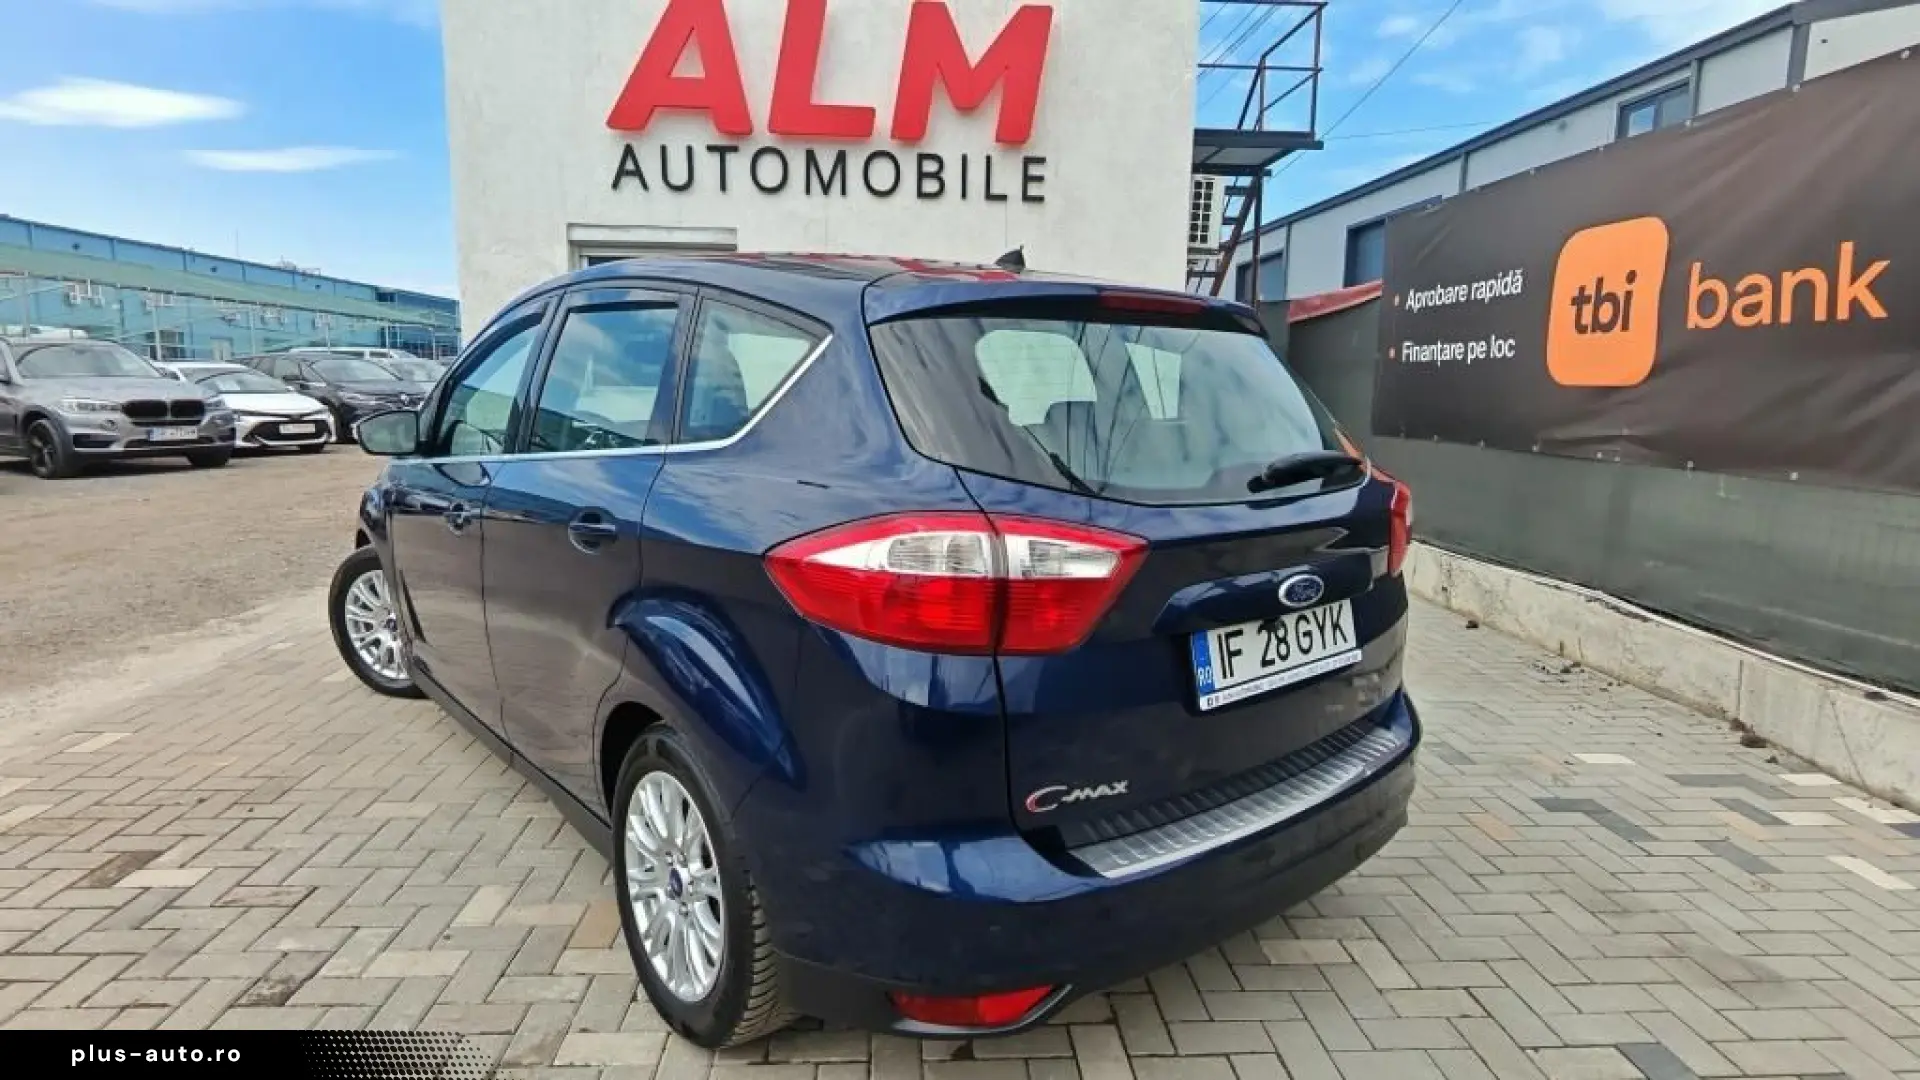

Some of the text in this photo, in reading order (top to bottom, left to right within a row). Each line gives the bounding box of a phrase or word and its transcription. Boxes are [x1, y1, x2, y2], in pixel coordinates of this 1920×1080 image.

[606, 0, 1053, 143] ALM
[611, 143, 1048, 203] AUTOMOBILE
[1405, 281, 1468, 313] Aprobare
[1570, 241, 1890, 333] tbi bank
[1467, 340, 1488, 364] pe
[1490, 333, 1516, 359] loc
[1217, 629, 1244, 680] IF
[1256, 617, 1291, 669] 28
[1295, 603, 1348, 655] GYK
